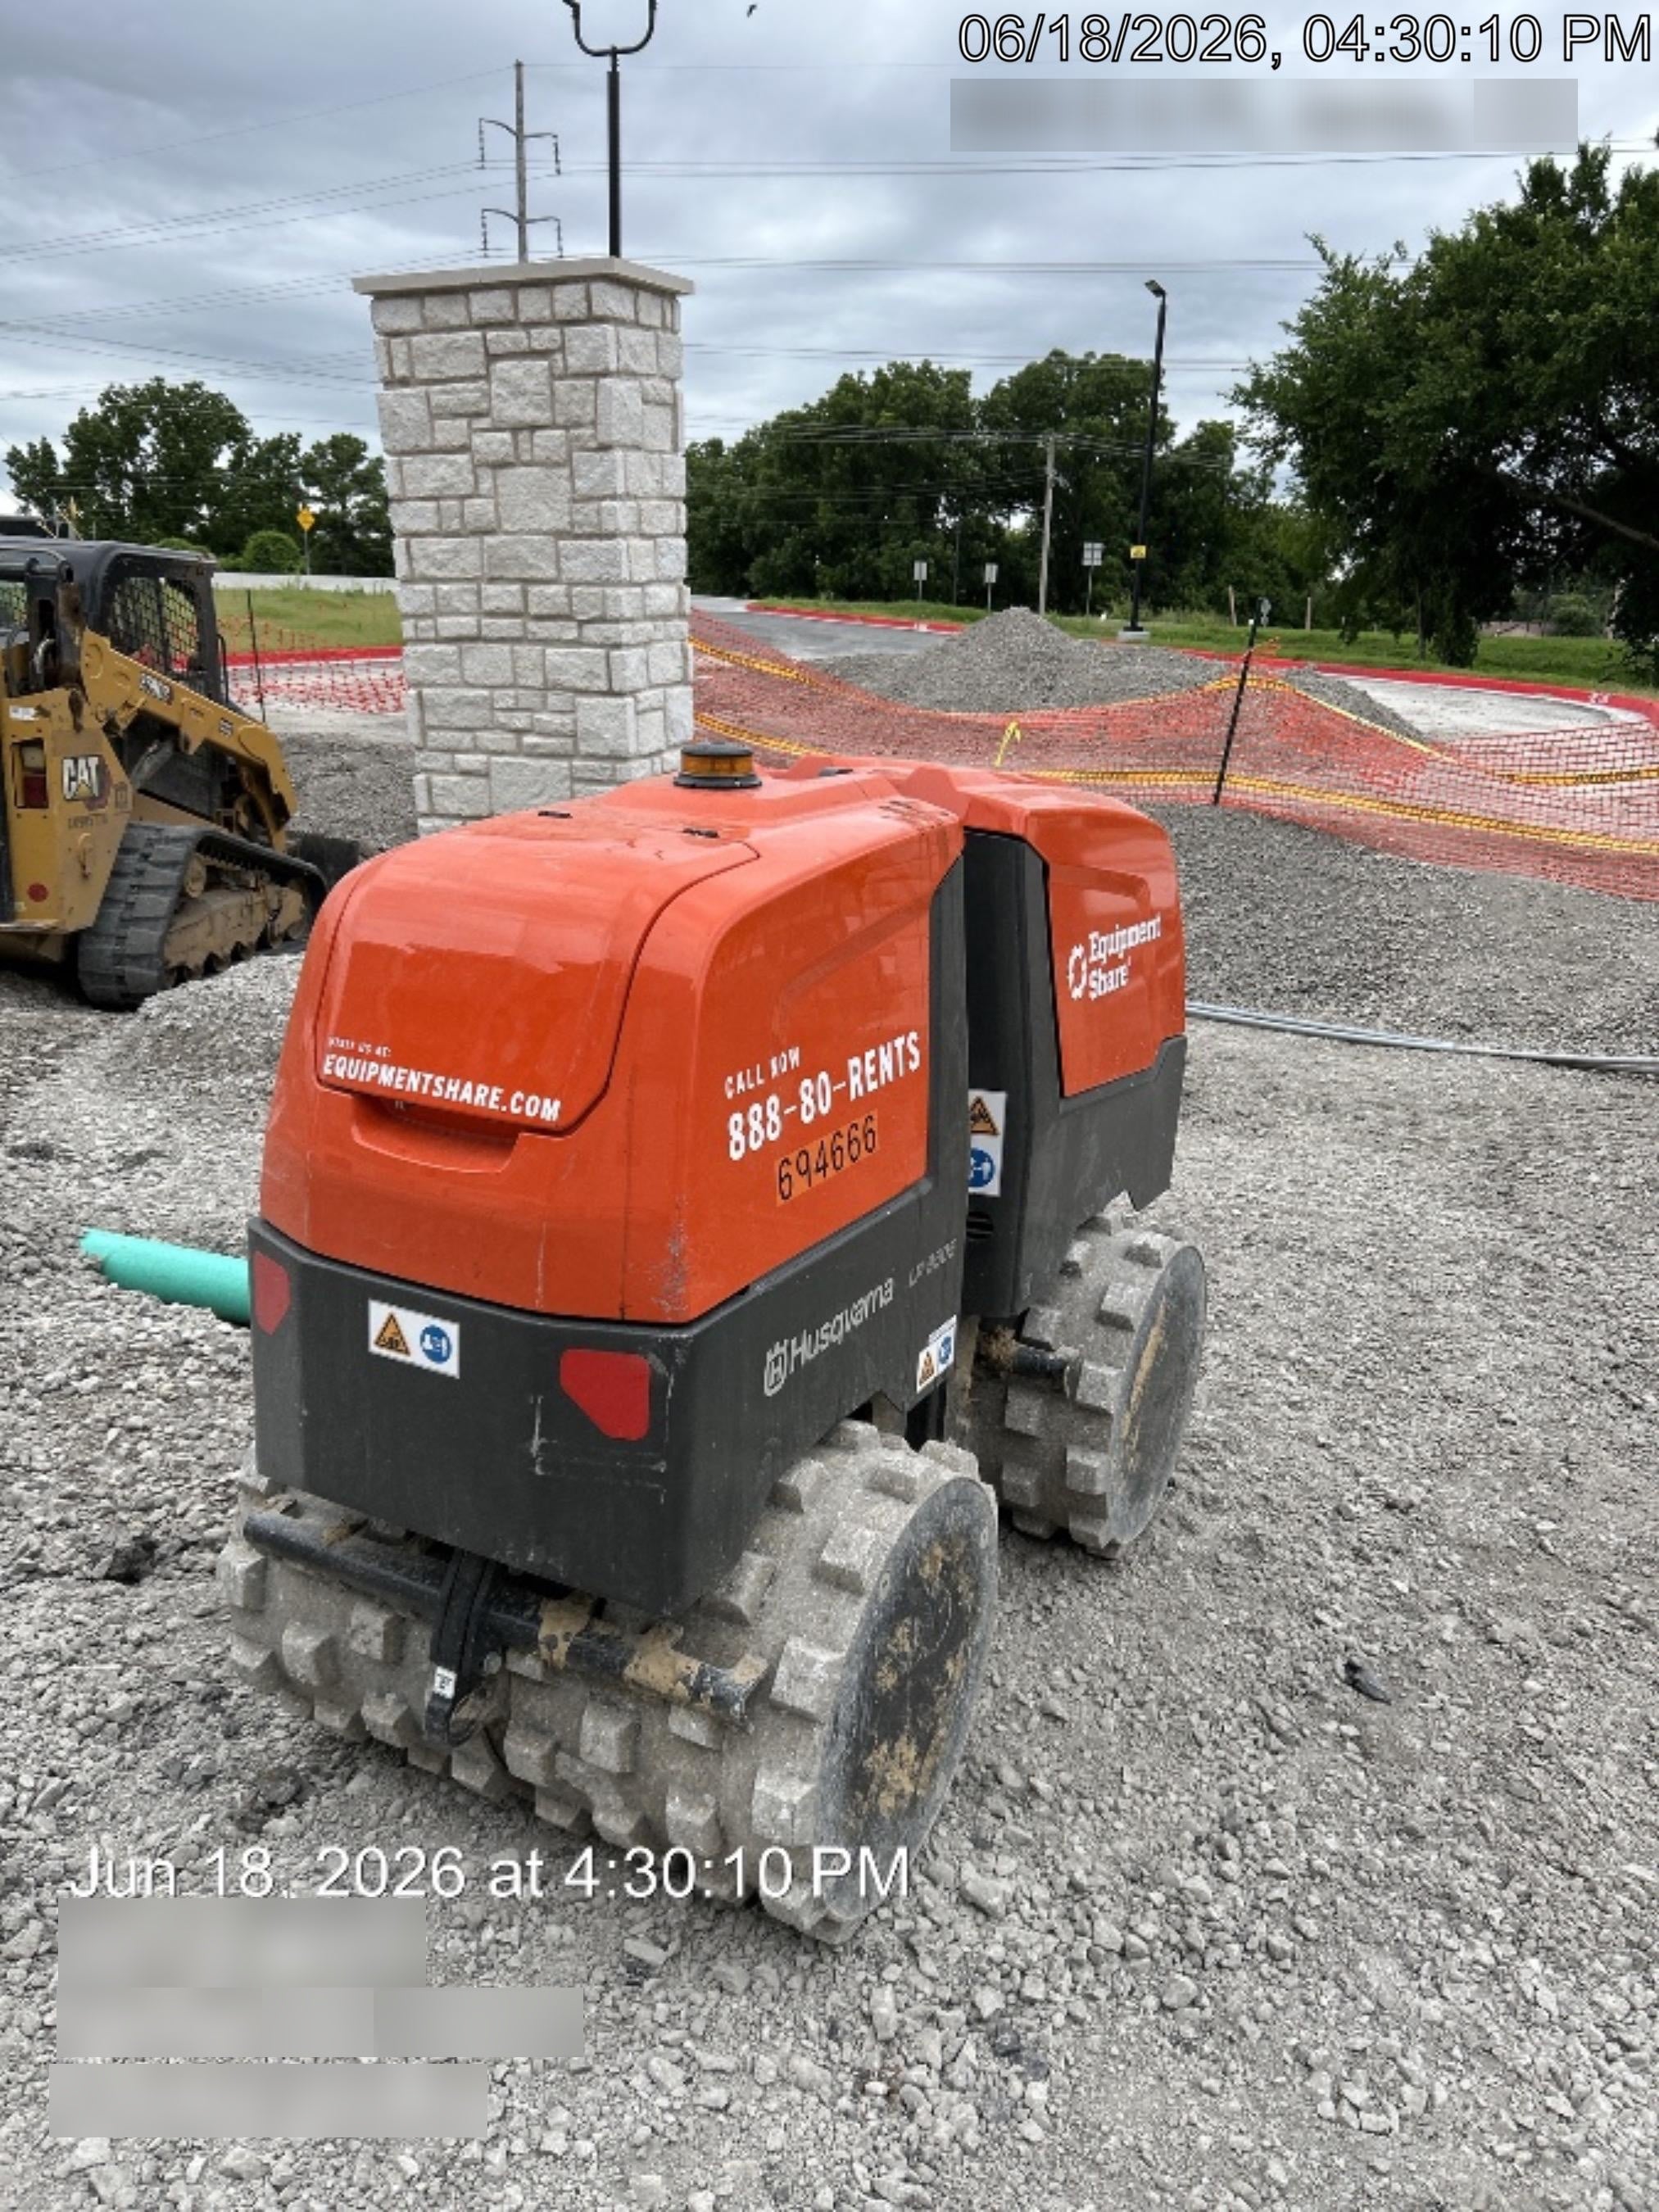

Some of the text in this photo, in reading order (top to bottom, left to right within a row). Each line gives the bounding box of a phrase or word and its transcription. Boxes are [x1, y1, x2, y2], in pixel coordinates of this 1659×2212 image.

[63, 756, 99, 800] CAT
[1088, 912, 1162, 965] Equipment
[1089, 963, 1129, 1000] Share
[323, 1054, 562, 1122] EQUIPMENTSHARE.COM
[724, 1046, 801, 1099] CALL NOW
[728, 1031, 921, 1160] 888-80-RENTS
[777, 1114, 877, 1201] 694666
[789, 1277, 895, 1374] Husqvarna
